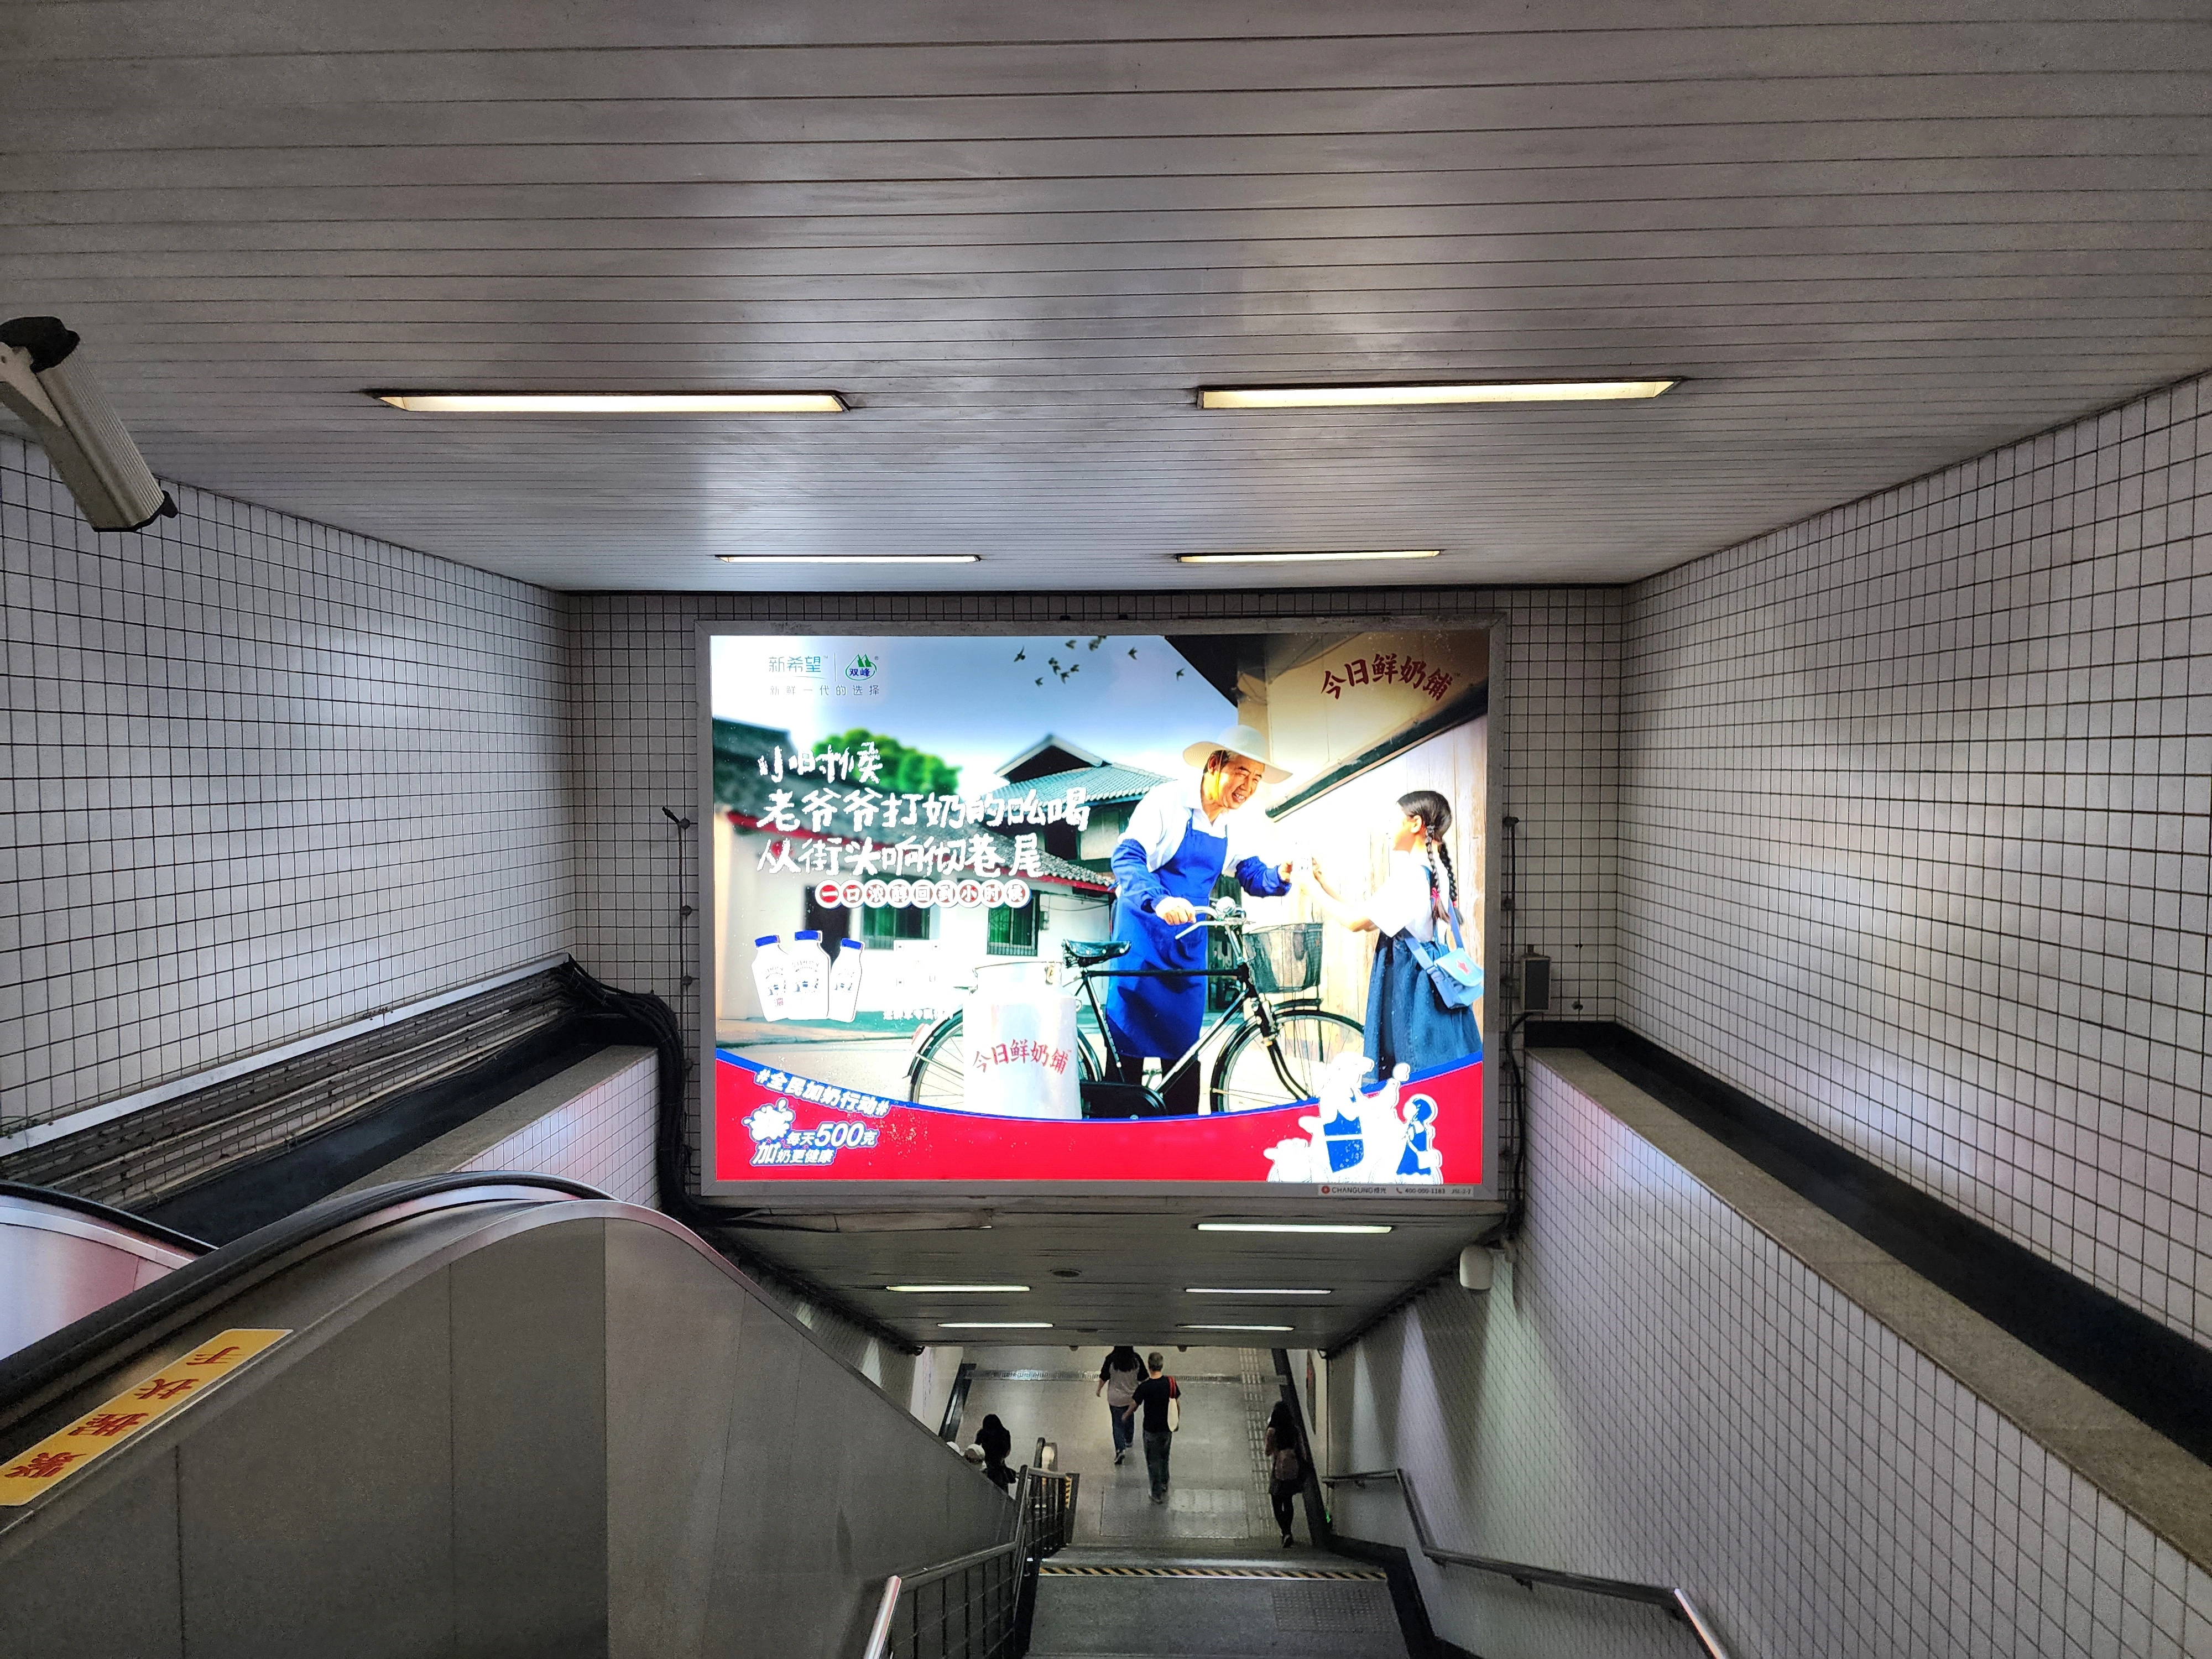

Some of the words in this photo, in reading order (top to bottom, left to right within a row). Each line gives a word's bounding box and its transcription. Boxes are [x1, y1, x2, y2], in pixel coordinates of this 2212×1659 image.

[769, 656, 821, 672] 新希望
[849, 668, 870, 677] 双峰
[1321, 653, 1453, 701] 今日鲜奶铺
[770, 685, 880, 696] 新鲜一代的选择
[757, 787, 1091, 832] 老爷爷打奶的吆喝
[757, 832, 1045, 878] 从街头响彻巷尾
[973, 1039, 1069, 1074] 今日鲜奶铺
[756, 1068, 890, 1116] #全民加奶行动#
[753, 1141, 835, 1164] 加奶更健康
[4, 1345, 245, 1479] 紧握扶手
